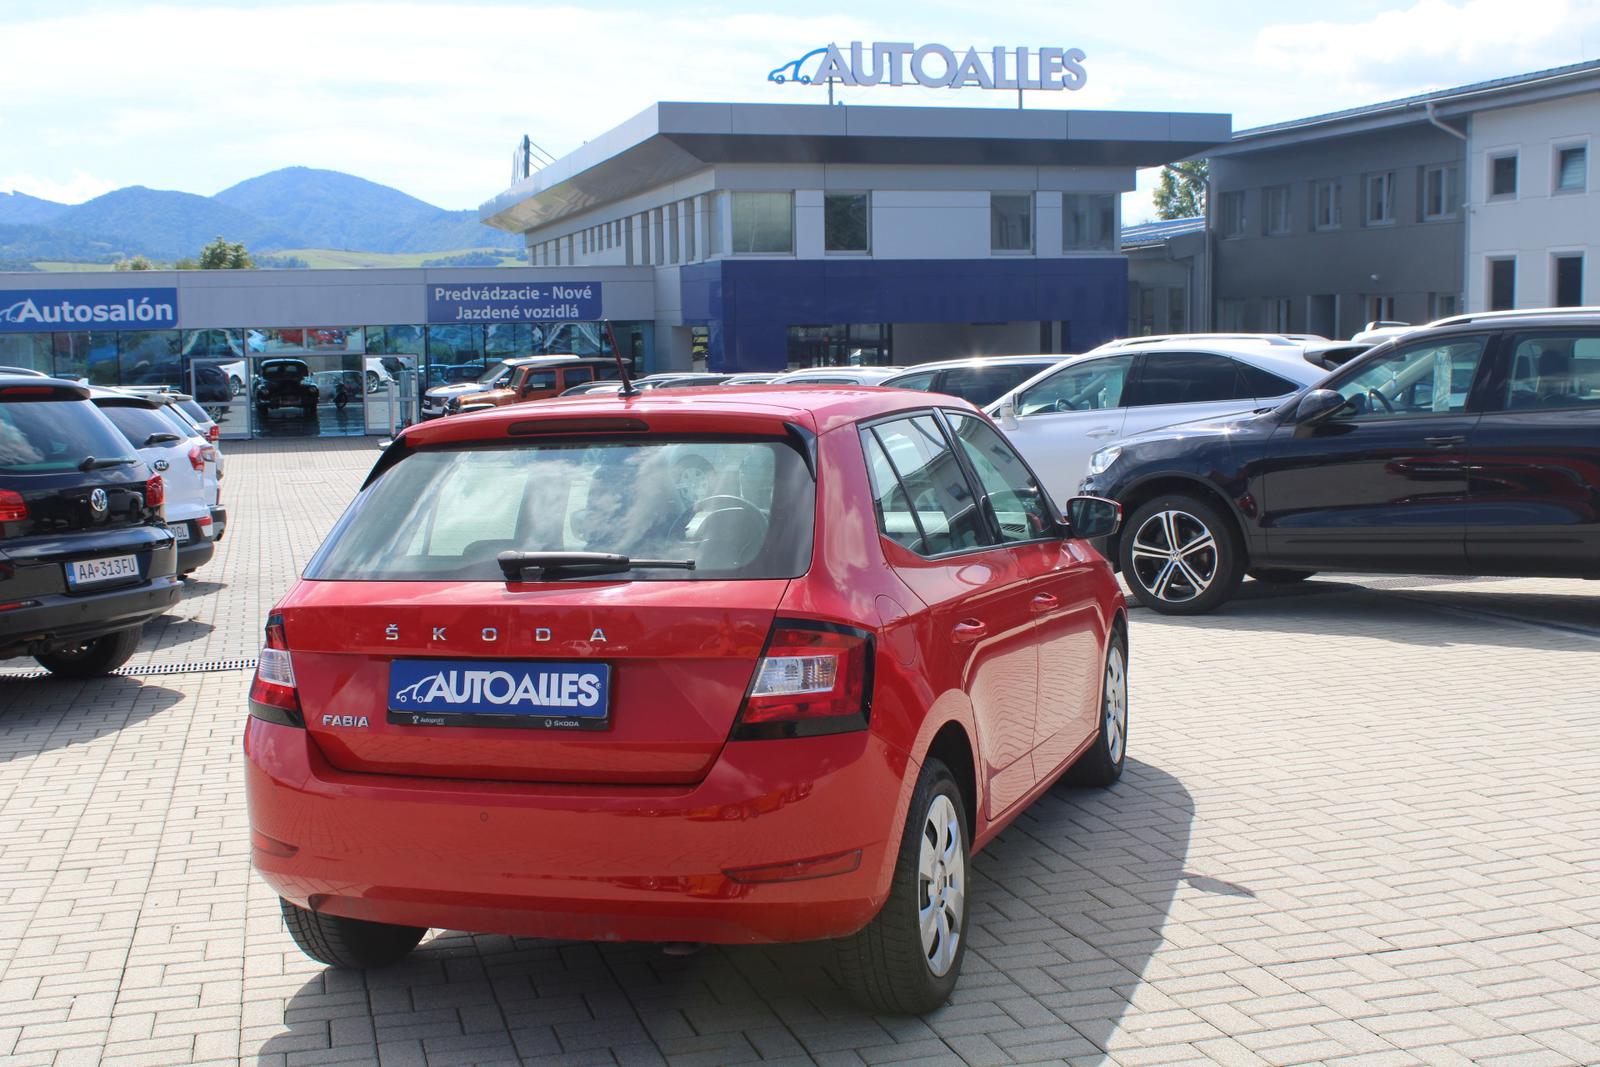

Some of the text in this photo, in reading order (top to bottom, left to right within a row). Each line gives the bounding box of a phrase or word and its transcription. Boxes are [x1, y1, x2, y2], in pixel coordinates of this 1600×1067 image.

[810, 41, 1087, 91] AUTOALLES
[434, 287, 539, 301] Predvádzacie
[552, 285, 592, 299] Nové
[17, 297, 173, 323] Autosalón
[456, 304, 579, 320] Jazdené vozidlá
[385, 624, 607, 642] ŠKODA
[423, 670, 600, 707] AUTOALLES
[322, 714, 369, 728] FABIA
